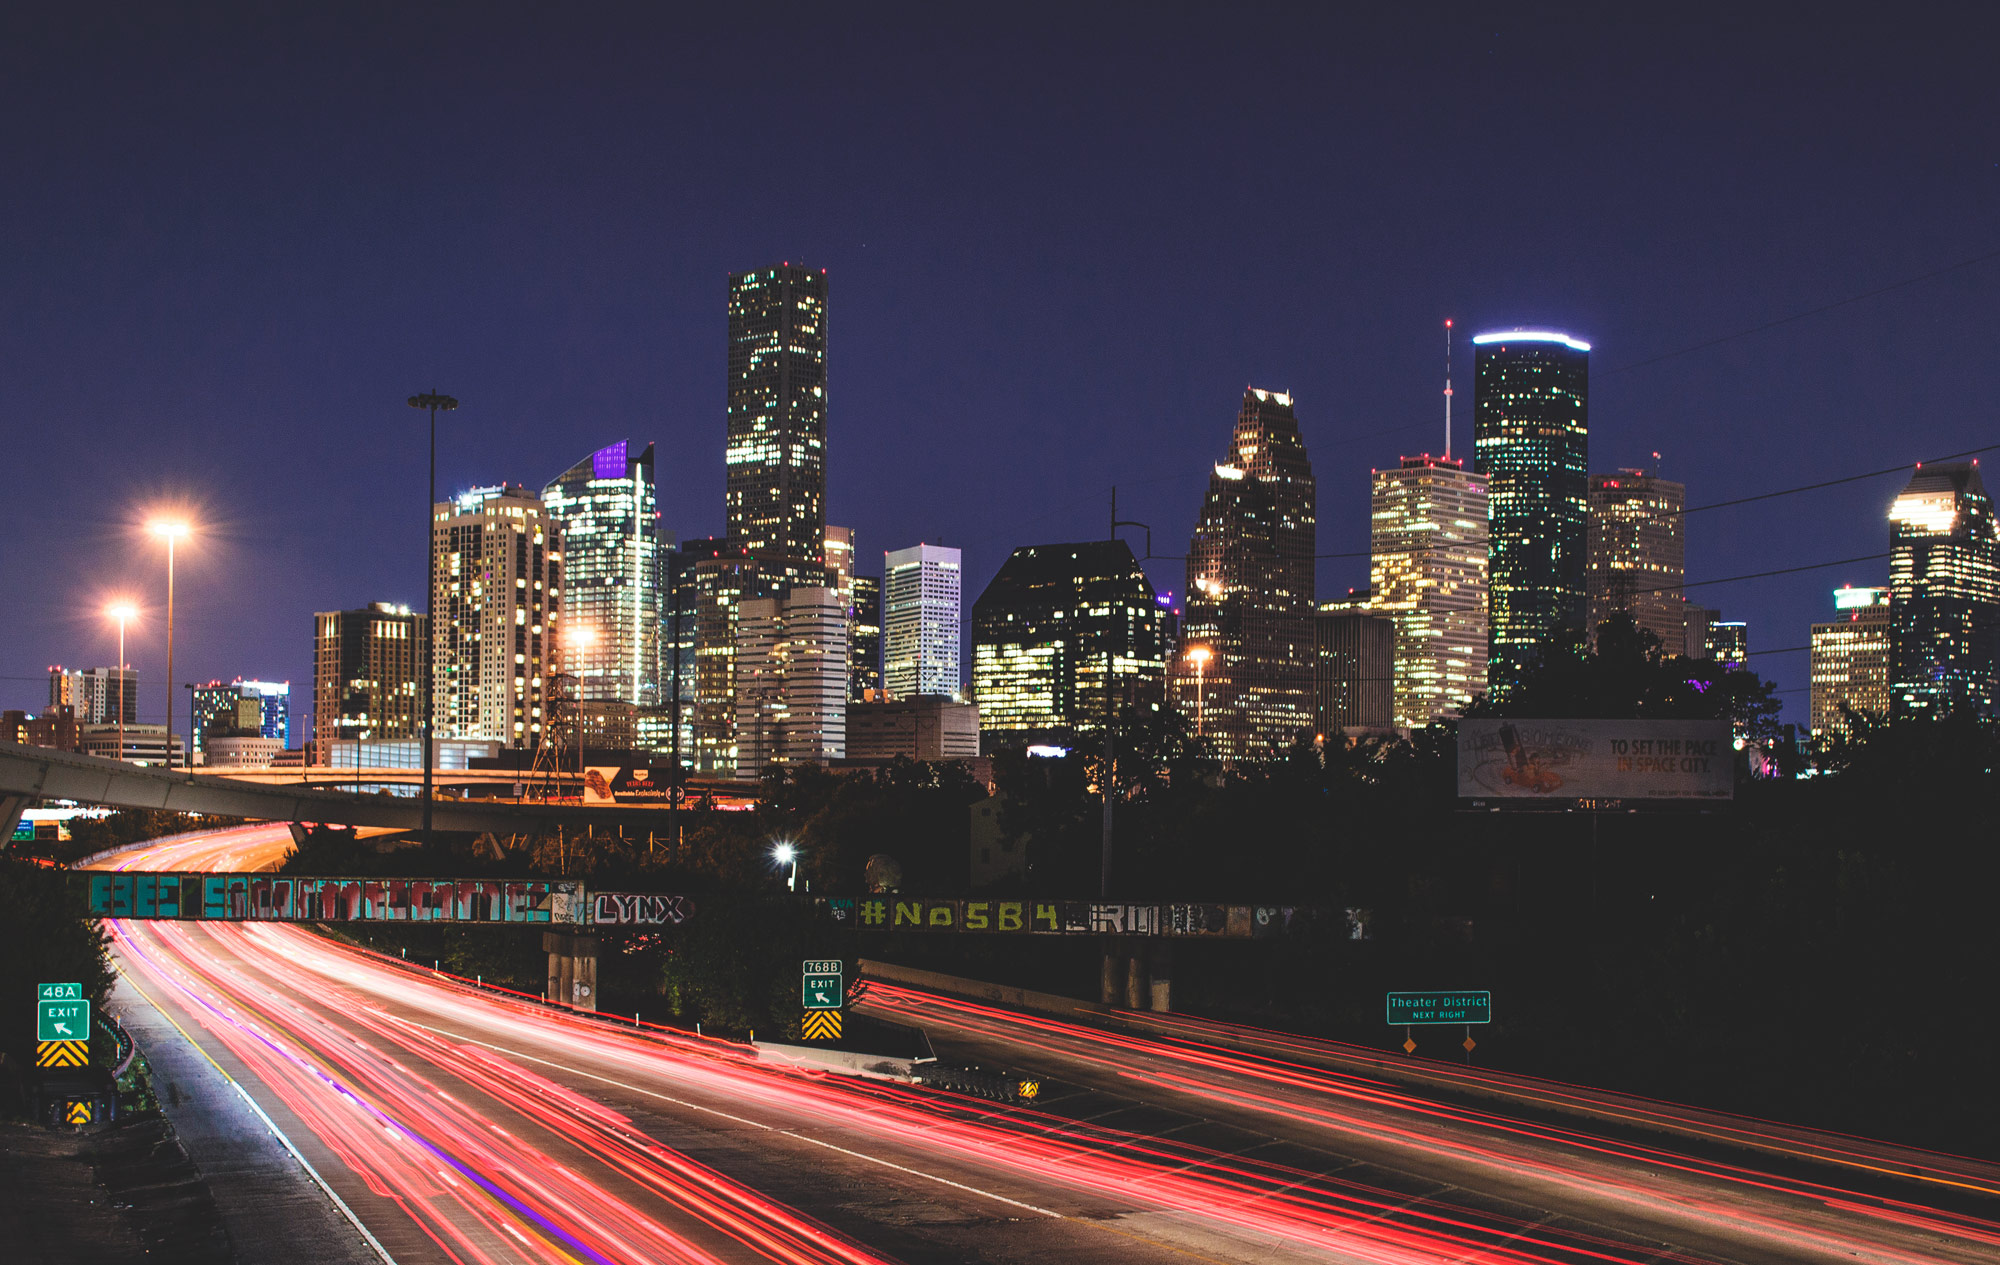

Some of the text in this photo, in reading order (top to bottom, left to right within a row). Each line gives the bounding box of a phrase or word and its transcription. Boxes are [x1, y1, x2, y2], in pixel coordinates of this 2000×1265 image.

[1610, 739, 1718, 756] TO SET THE PACE
[1617, 757, 1711, 773] IN SPACE CITY.
[594, 894, 685, 924] LYNX
[808, 962, 838, 972] 768B
[810, 979, 834, 989] EXIT
[43, 986, 76, 998] 48A
[1391, 995, 1488, 1008] Theater District
[48, 1007, 79, 1017] EXIT
[1412, 1010, 1466, 1019] NEXT RIGHT
